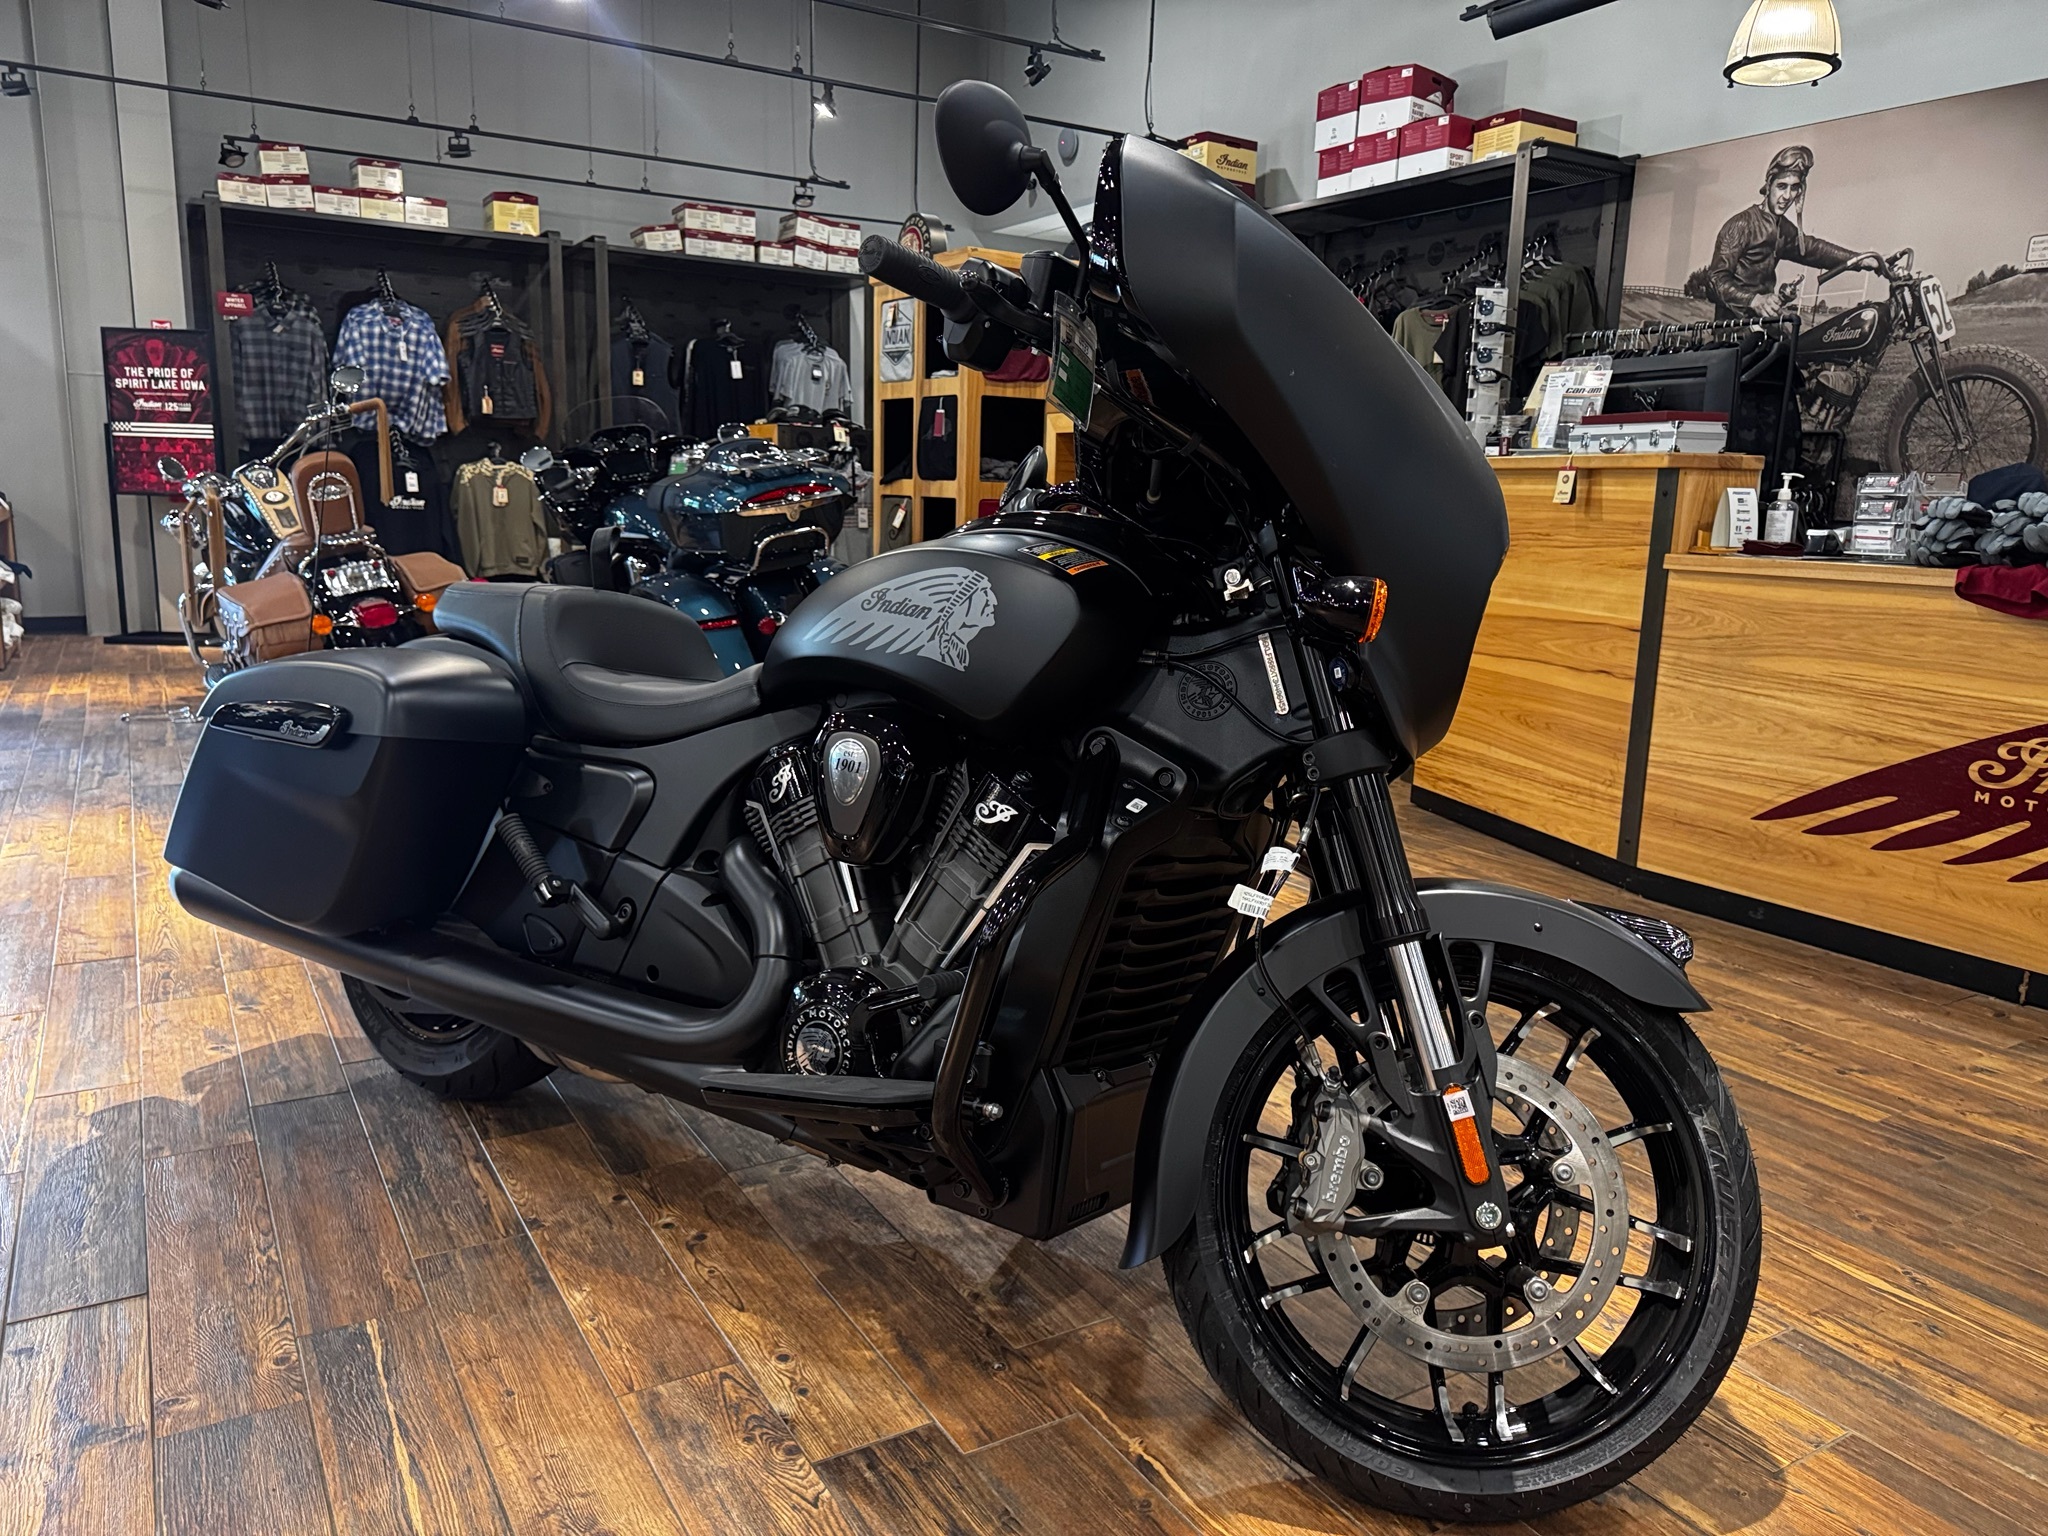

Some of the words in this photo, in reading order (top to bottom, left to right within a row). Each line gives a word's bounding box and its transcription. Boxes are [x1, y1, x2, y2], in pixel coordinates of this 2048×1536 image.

[1215, 153, 1249, 171] Indian
[1921, 283, 1954, 335] 52
[1822, 326, 1862, 343] Indian
[124, 366, 145, 378] THE
[147, 367, 178, 379] PRIDE
[180, 368, 195, 379] OF
[115, 378, 149, 390] SPIRIT
[151, 379, 179, 391] LAKE
[180, 380, 206, 391] IOWA
[165, 402, 179, 411] 125
[861, 587, 933, 621] Indian
[279, 719, 310, 739] Indian
[835, 757, 862, 774] 1901
[785, 1014, 806, 1070] INDIAN
[809, 1008, 852, 1076] MOTORCYCL
[1321, 1134, 1352, 1204] brembo
